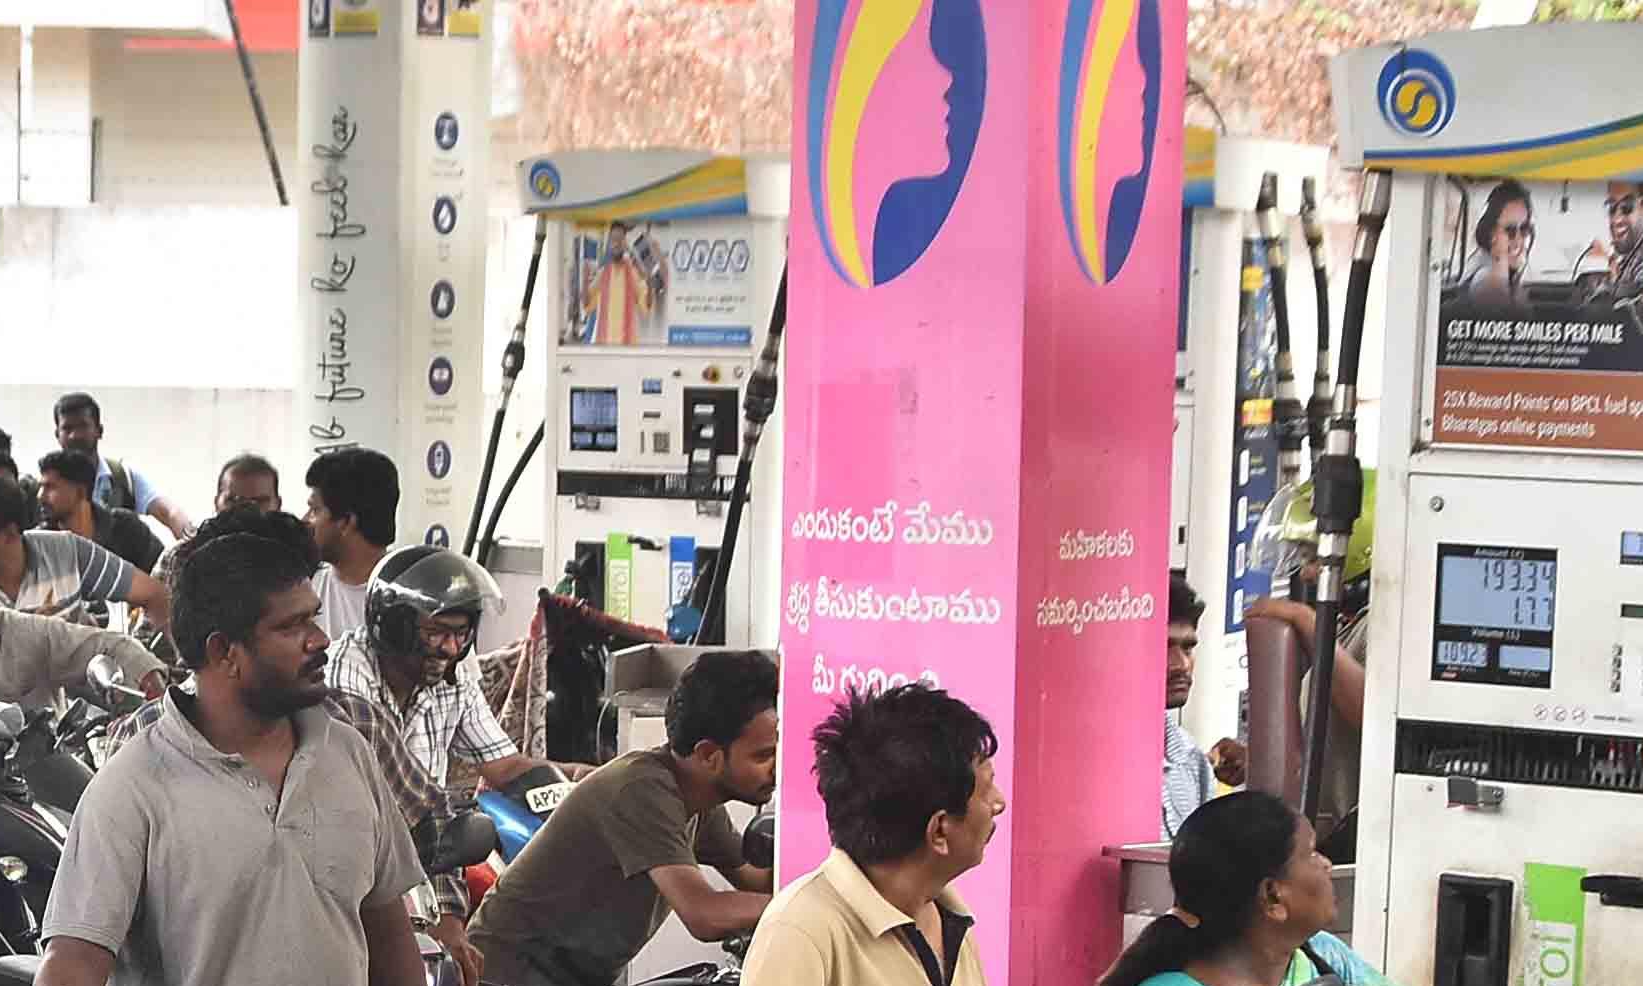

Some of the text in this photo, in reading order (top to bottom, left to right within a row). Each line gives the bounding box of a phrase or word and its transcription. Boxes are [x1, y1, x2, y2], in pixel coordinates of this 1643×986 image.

[311, 175, 367, 239] feel
[1447, 319, 1624, 344] GET MORE SMILES PER MILE
[314, 307, 365, 402] future
[1443, 390, 1465, 409] 25X
[1466, 391, 1513, 410] Reward
[1553, 397, 1569, 410] on
[1603, 395, 1628, 416] fuel
[1441, 414, 1597, 440] Bharatgas online payments
[791, 500, 994, 546] ఎందుకంటే మేము
